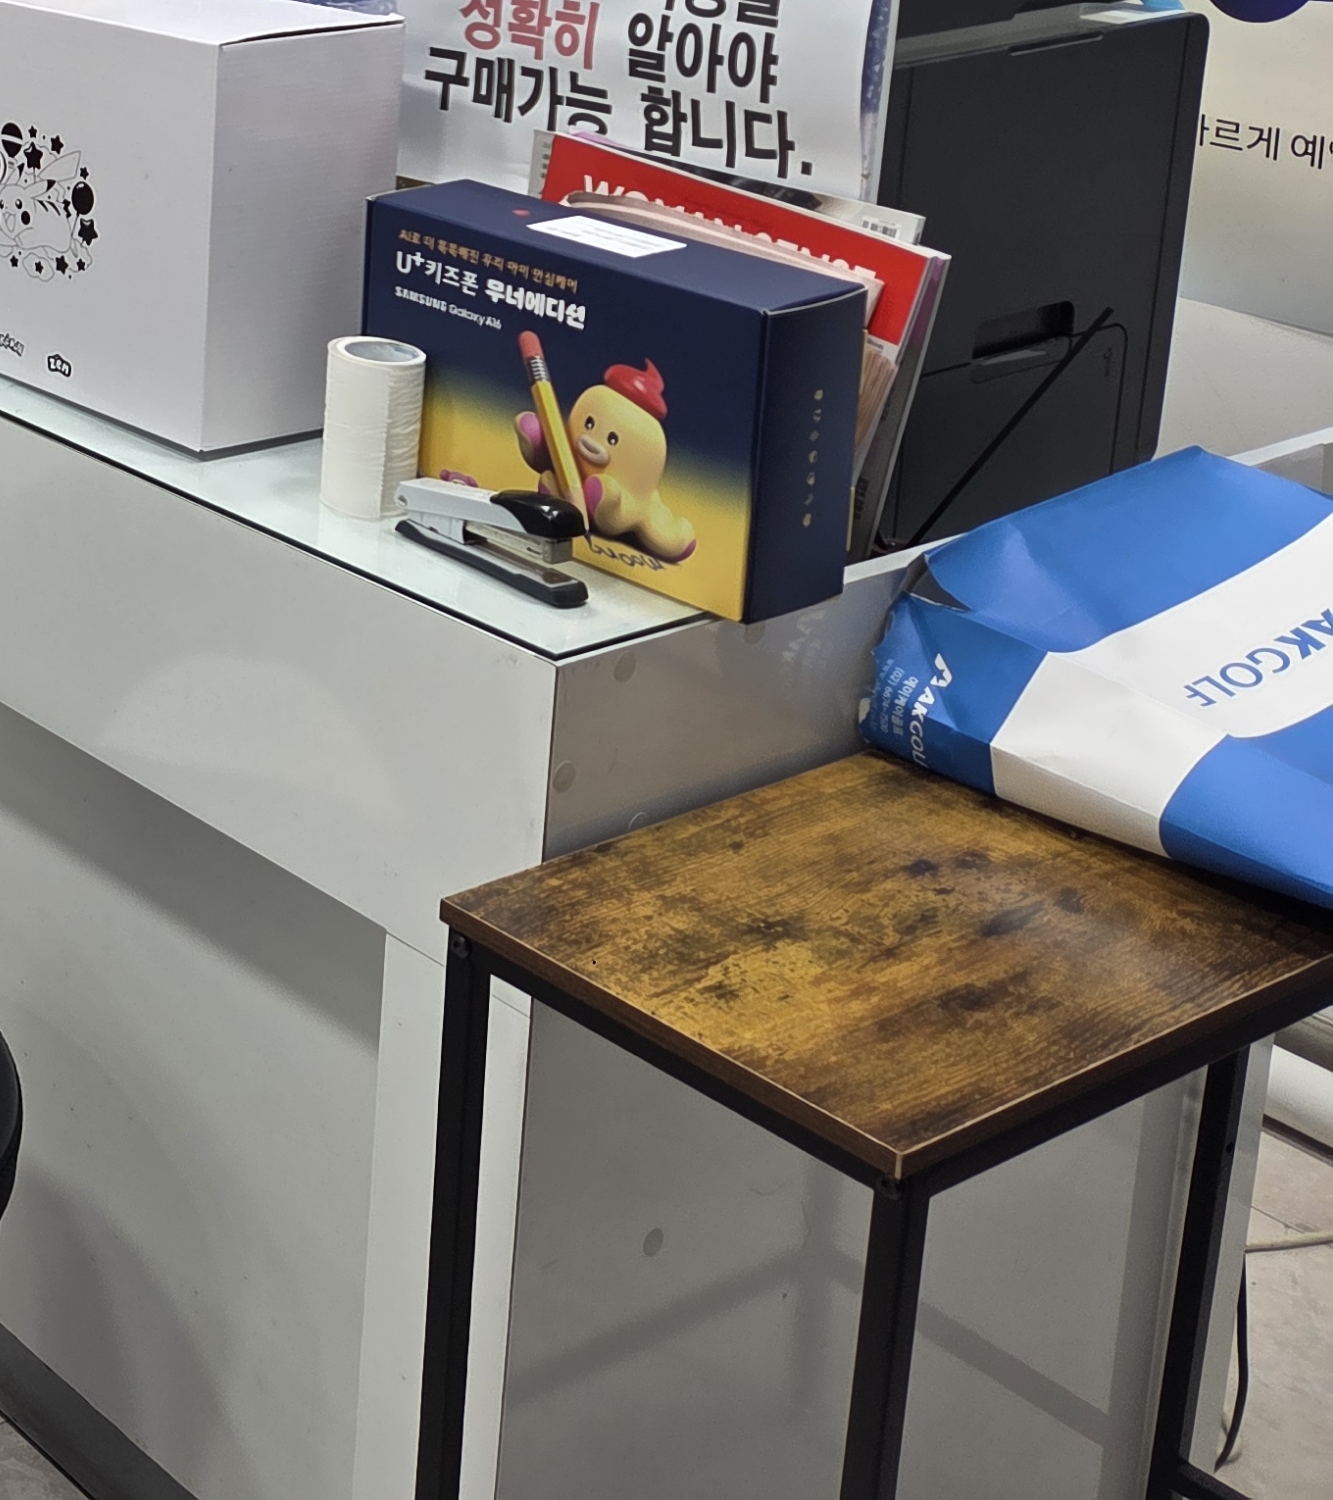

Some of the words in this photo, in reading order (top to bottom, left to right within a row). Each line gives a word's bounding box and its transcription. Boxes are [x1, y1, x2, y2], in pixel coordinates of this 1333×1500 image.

[627, 10, 779, 104] 알아야
[424, 45, 612, 135] 구매가능
[639, 86, 814, 178] 합니다.
[394, 285, 447, 312] SAMSUNG
[485, 278, 586, 330] 무너에디션
